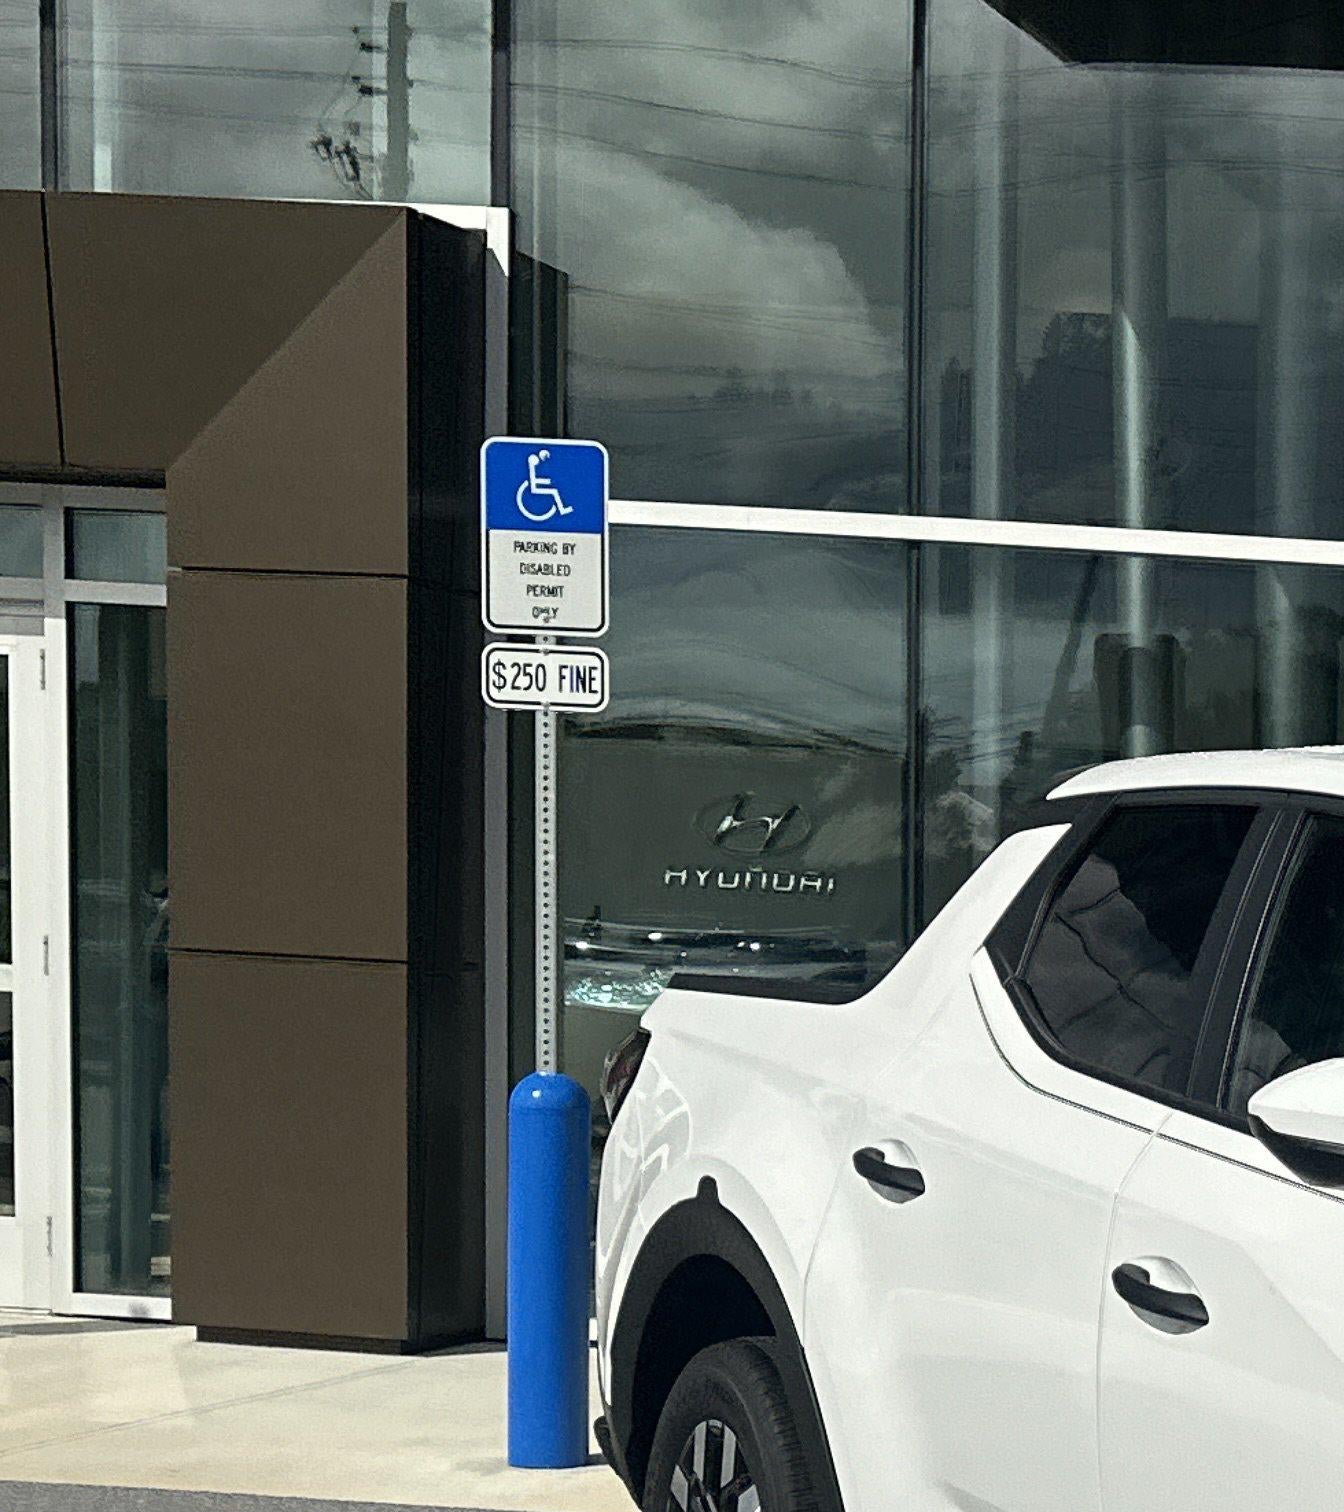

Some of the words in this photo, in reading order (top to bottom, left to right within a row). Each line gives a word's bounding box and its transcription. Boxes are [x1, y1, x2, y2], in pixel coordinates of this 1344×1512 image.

[513, 540, 558, 555] PARKING
[562, 542, 576, 556] BY
[519, 562, 571, 576] DISABLED
[526, 584, 564, 598] PERMIT
[492, 659, 547, 693] $250
[558, 664, 599, 694] FINE
[664, 867, 835, 893] HYUNDAI
